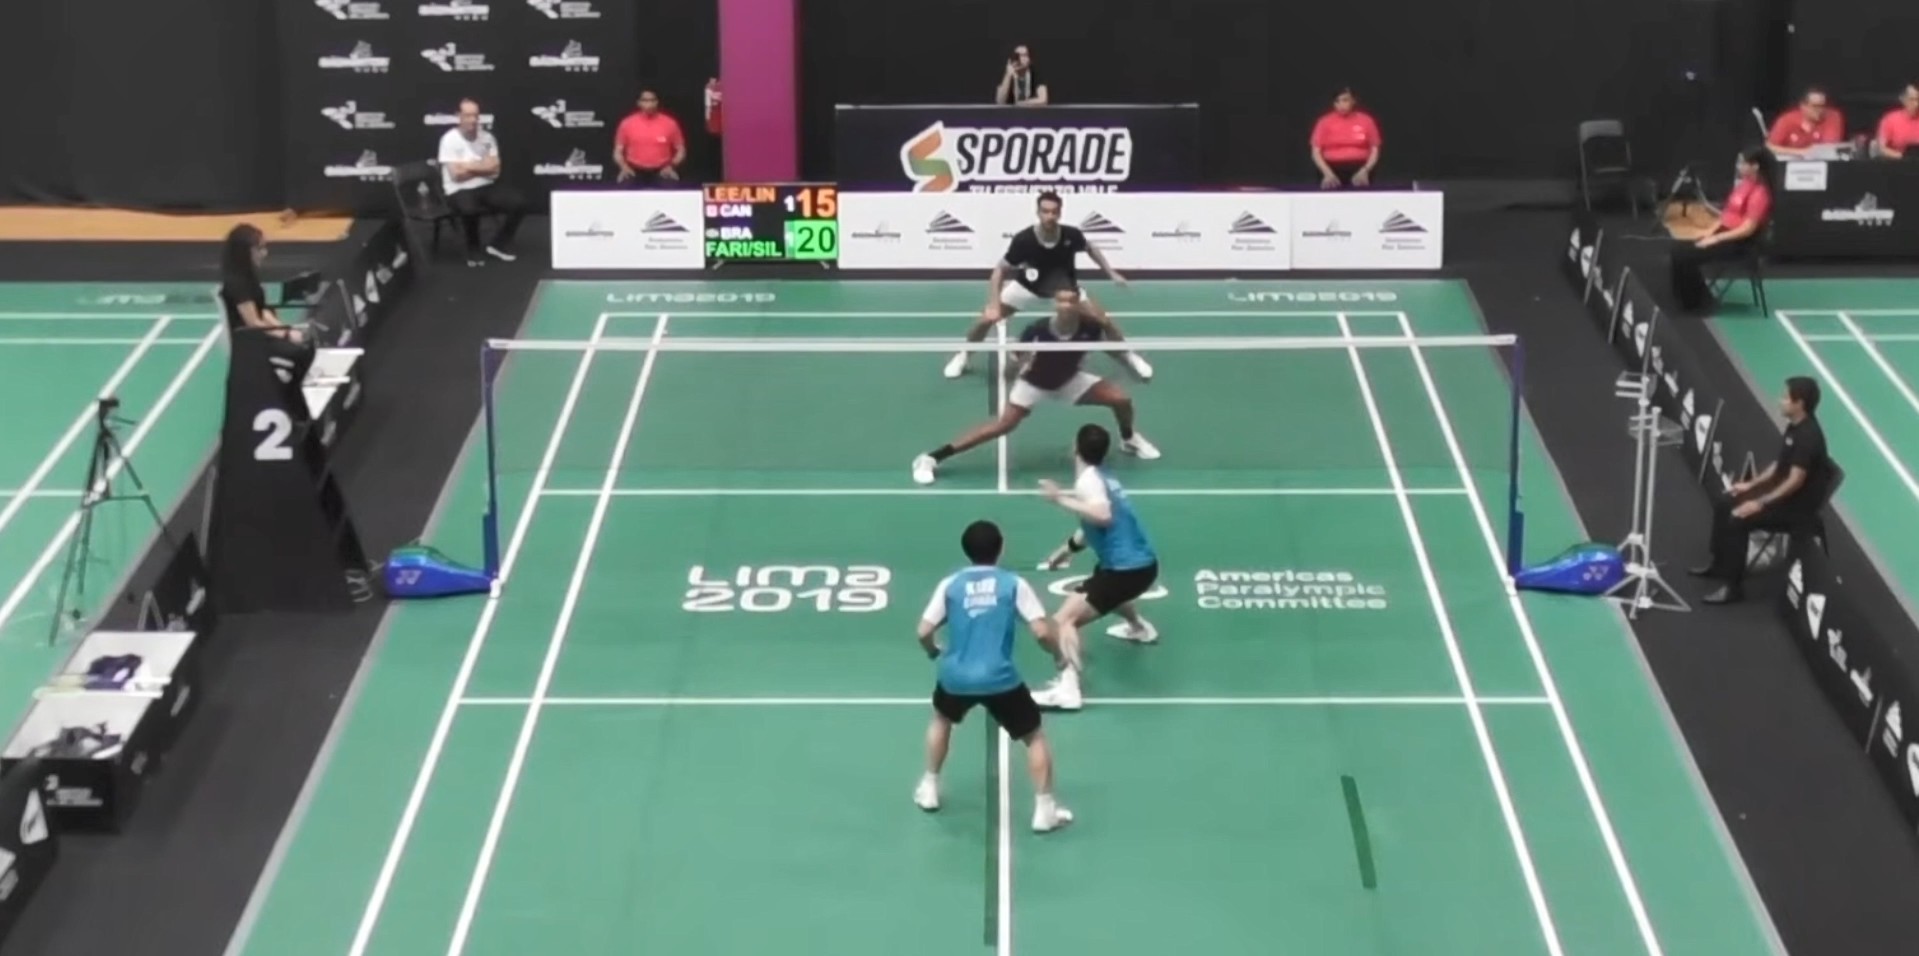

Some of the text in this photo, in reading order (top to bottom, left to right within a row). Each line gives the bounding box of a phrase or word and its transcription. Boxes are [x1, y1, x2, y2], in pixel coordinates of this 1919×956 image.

[957, 133, 1126, 175] SPORADE
[704, 187, 776, 203] LEE/LIN
[796, 188, 836, 218] 15
[720, 204, 753, 217] CAN
[720, 227, 753, 240] BRA
[797, 226, 836, 253] 20
[705, 241, 783, 258] FARI/SIL
[251, 408, 294, 461] 2
[1194, 569, 1354, 582] Americas
[1196, 582, 1387, 597] Paralympic
[681, 587, 889, 612] 2019
[1197, 596, 1387, 609] Committee
